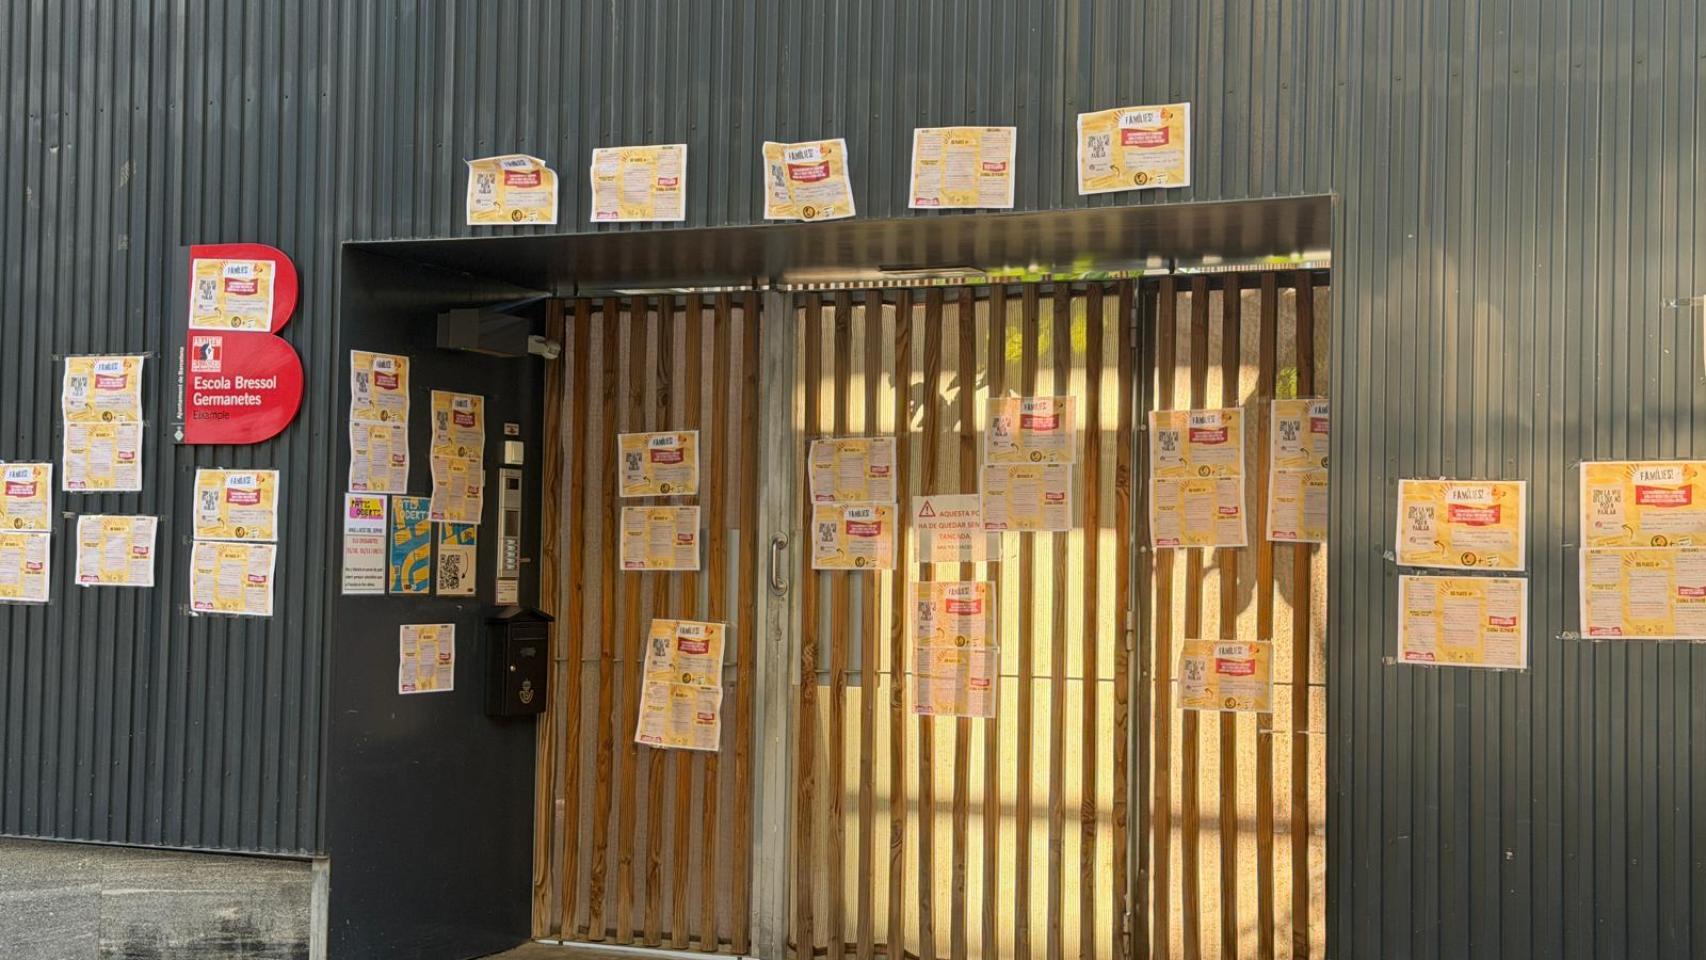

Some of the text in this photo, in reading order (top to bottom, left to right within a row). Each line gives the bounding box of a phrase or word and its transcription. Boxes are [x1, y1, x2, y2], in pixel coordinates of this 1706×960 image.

[194, 375, 277, 390] Escola Bressol
[193, 392, 262, 406] Germanetes
[939, 510, 970, 518] AQUESTA
